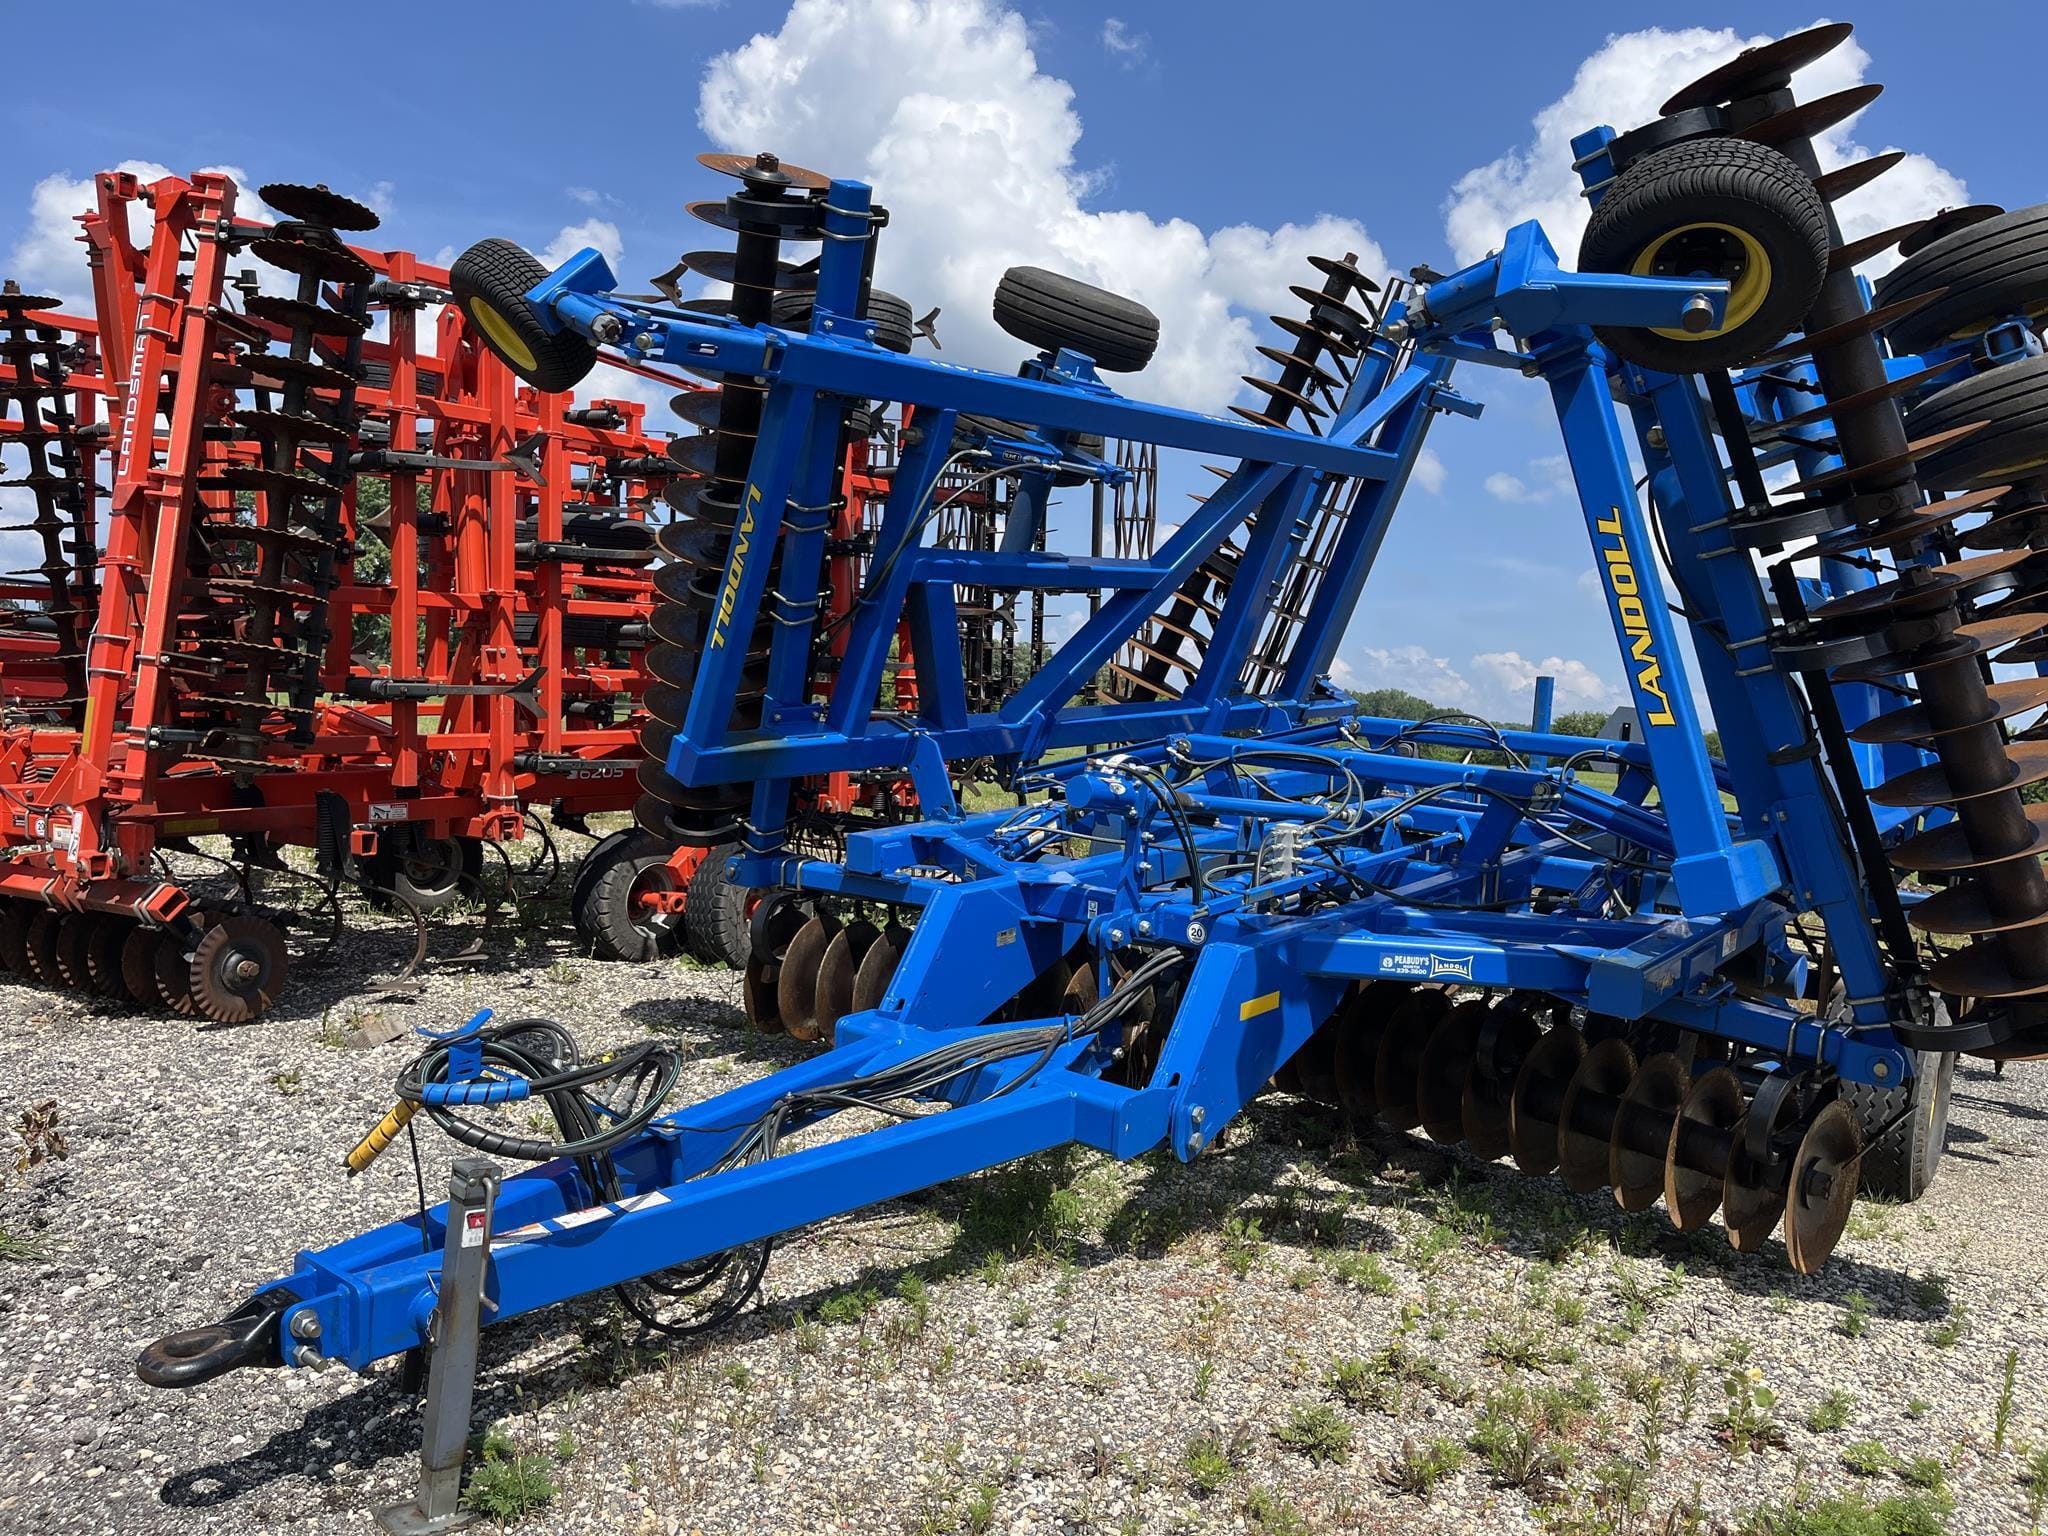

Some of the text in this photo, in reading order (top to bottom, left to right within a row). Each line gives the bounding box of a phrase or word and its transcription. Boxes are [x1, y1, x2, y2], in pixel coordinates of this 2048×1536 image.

[711, 483, 762, 649] LANDOLL
[1597, 506, 1677, 727] LANDOLL
[1191, 928, 1203, 938] 20
